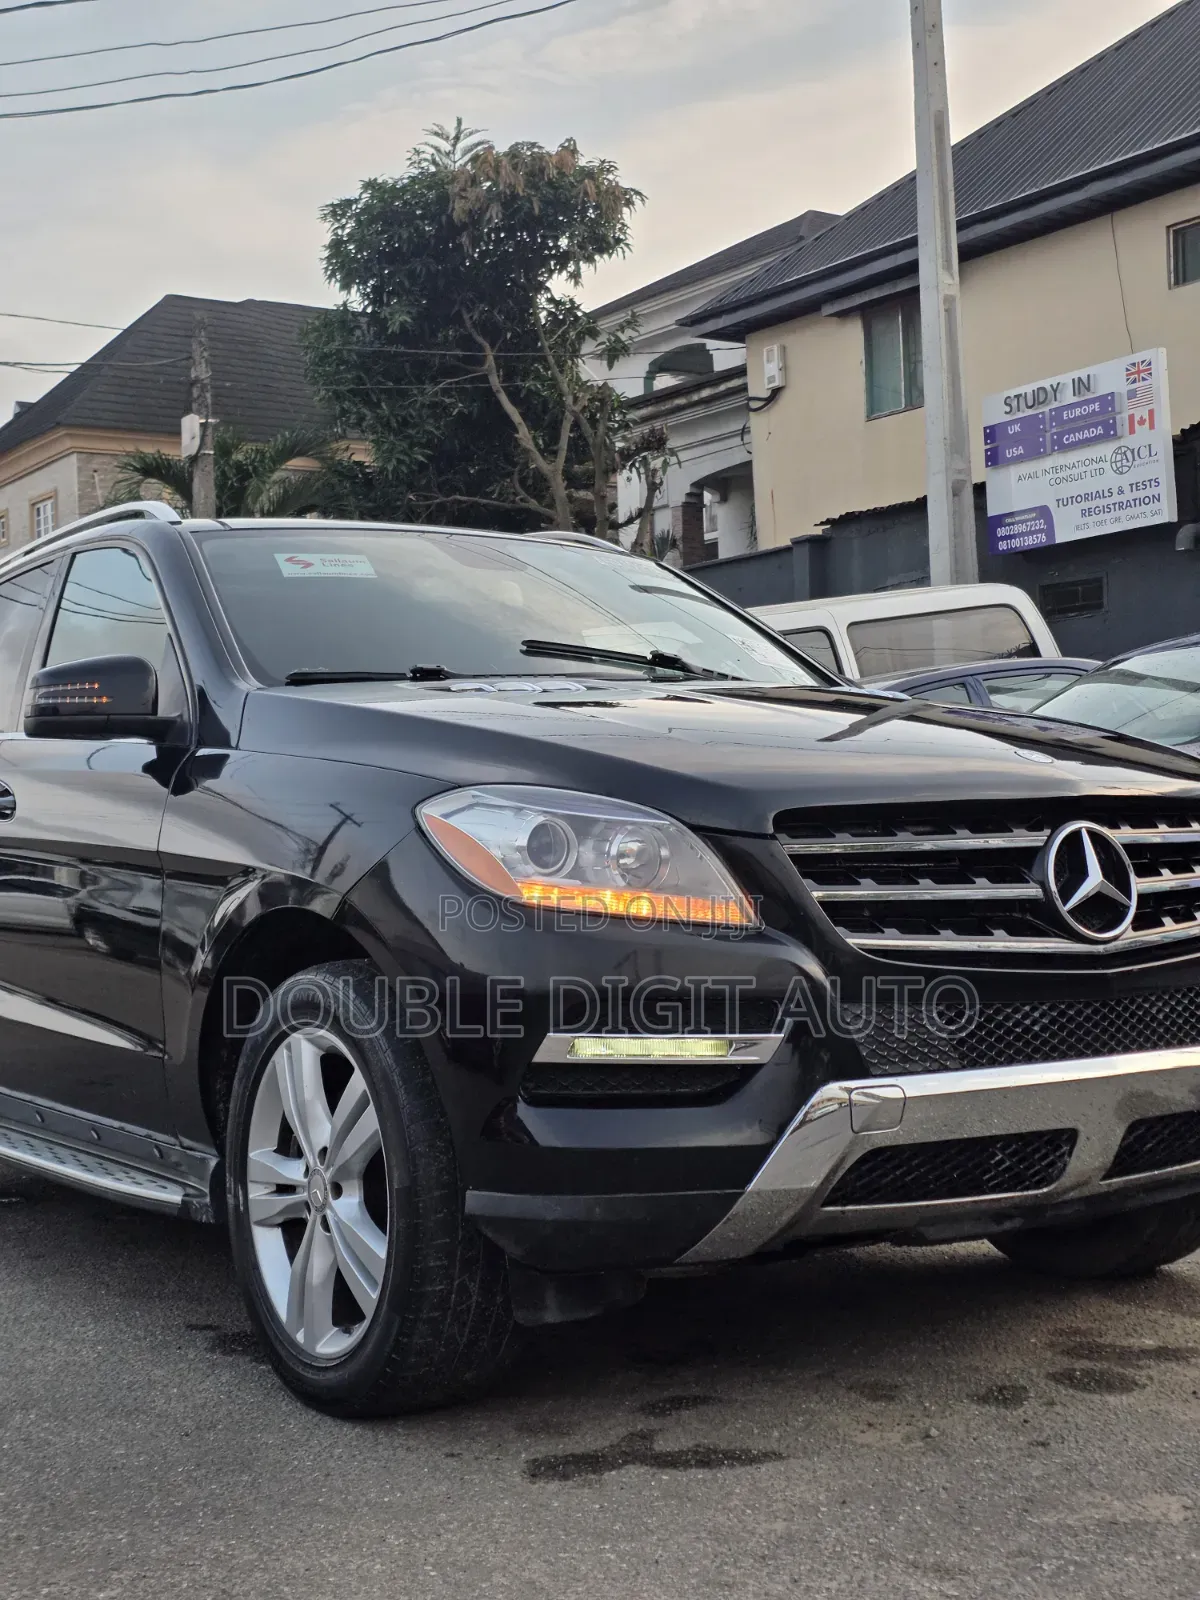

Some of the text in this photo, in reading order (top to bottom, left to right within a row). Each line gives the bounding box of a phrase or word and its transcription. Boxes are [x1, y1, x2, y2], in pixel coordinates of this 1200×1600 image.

[1003, 374, 1092, 415] STUDY IN
[1063, 402, 1101, 420] EUROPE
[1008, 423, 1022, 434] UK
[1063, 426, 1104, 444] CANADA
[1005, 445, 1024, 458] USA
[1121, 444, 1158, 464] AICL
[1017, 454, 1108, 483] AVAIL INTERNATIONAL
[1049, 471, 1088, 487] CONSULT
[1056, 477, 1161, 508] TUTORIALS & TESTS
[1081, 493, 1161, 518] REGISTRATION
[998, 533, 1047, 551] 08100138576
